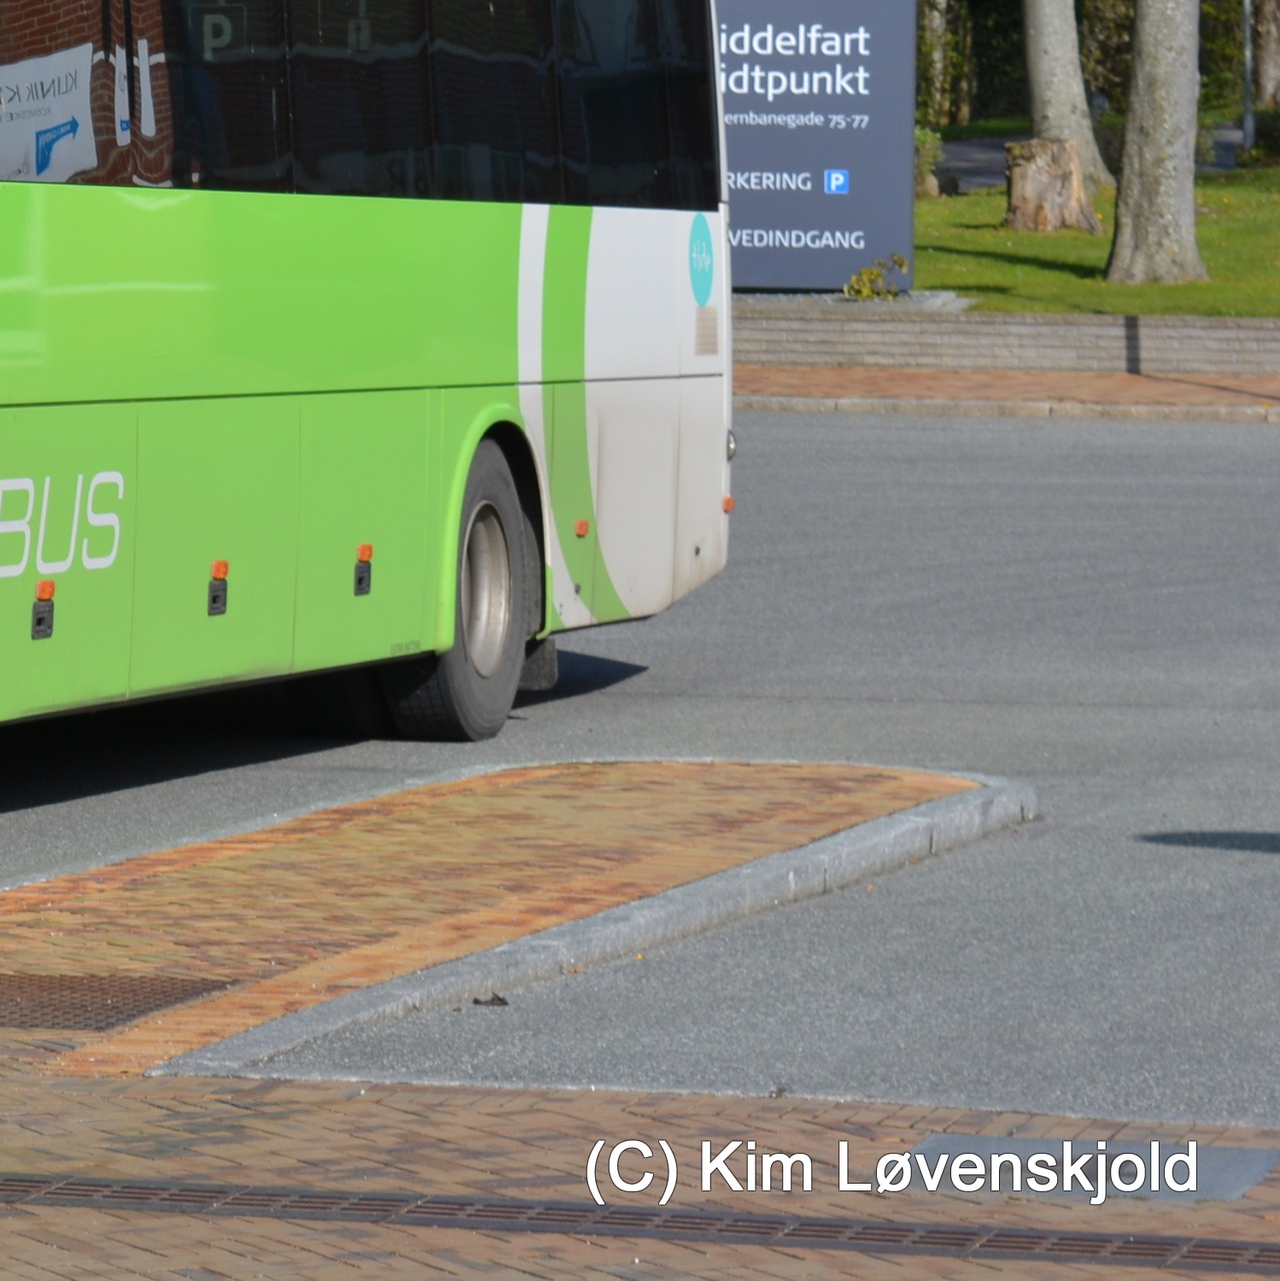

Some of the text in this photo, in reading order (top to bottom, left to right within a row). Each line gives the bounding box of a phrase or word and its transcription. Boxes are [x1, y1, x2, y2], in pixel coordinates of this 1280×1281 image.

[719, 23, 871, 56] iddelfart
[719, 63, 871, 102] idtpunkt
[724, 111, 870, 130] ernbanegade 75-77
[726, 172, 845, 192] RKERING P
[728, 229, 866, 249] VEDINDGANG
